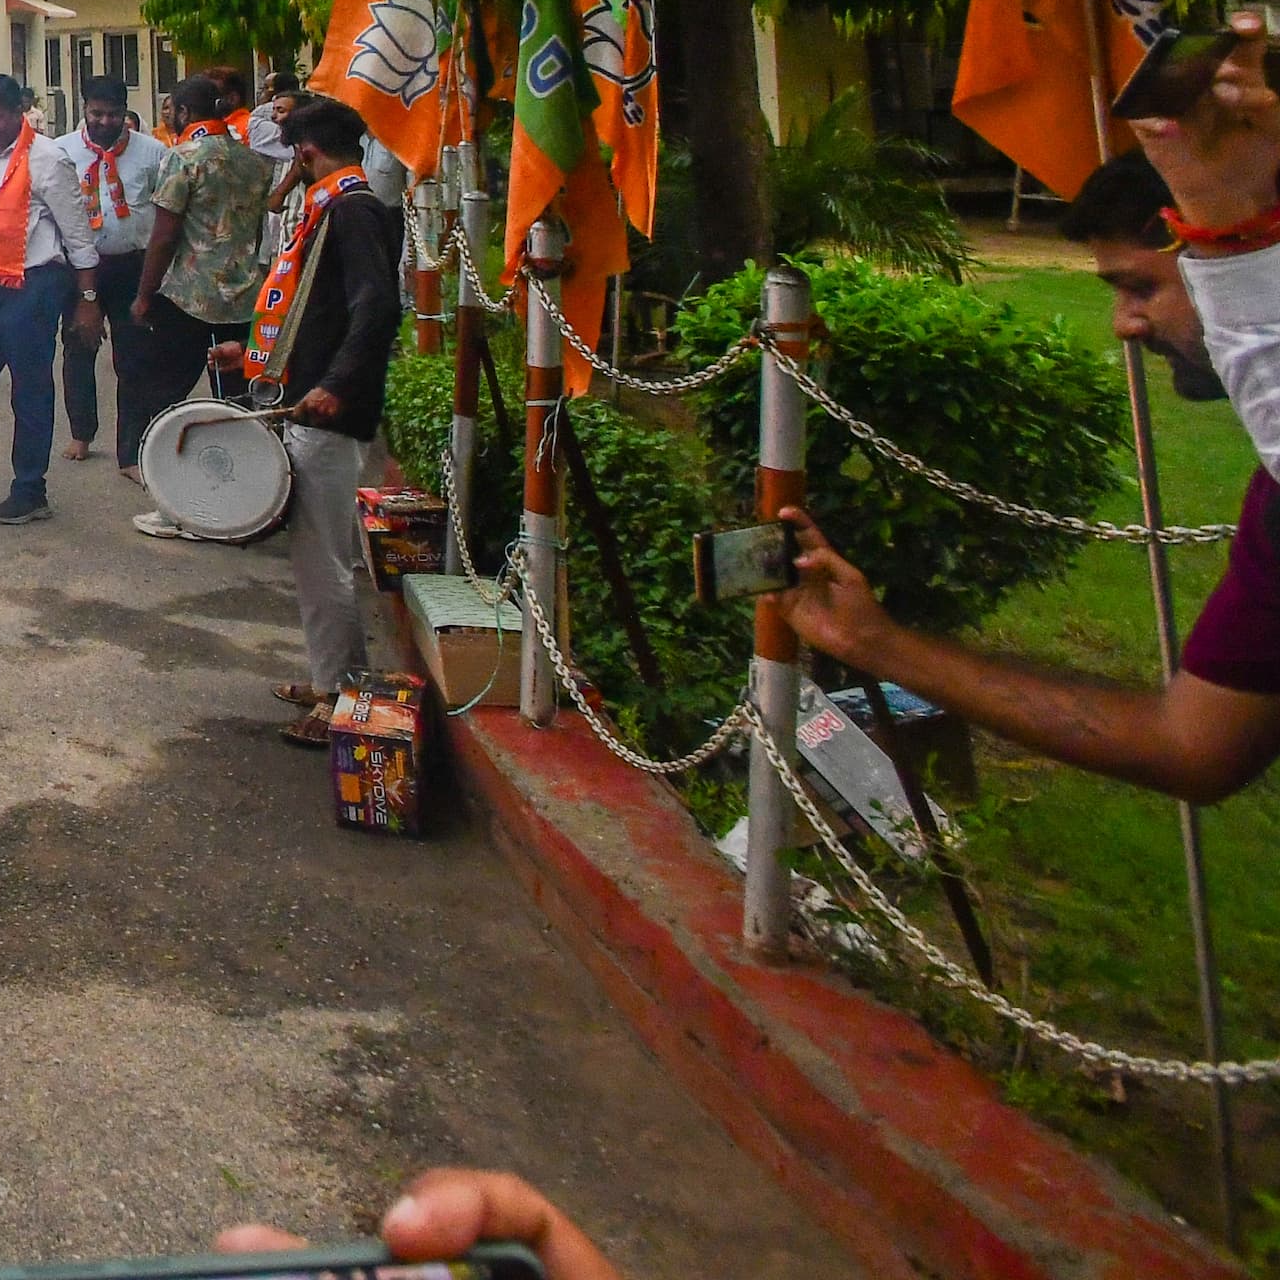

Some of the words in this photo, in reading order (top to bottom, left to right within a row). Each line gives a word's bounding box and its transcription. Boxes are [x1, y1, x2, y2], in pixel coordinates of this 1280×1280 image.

[266, 287, 284, 311] P
[248, 350, 270, 364] BJ
[385, 552, 443, 562] SKYDIV
[370, 751, 388, 825] SKYDIVE
